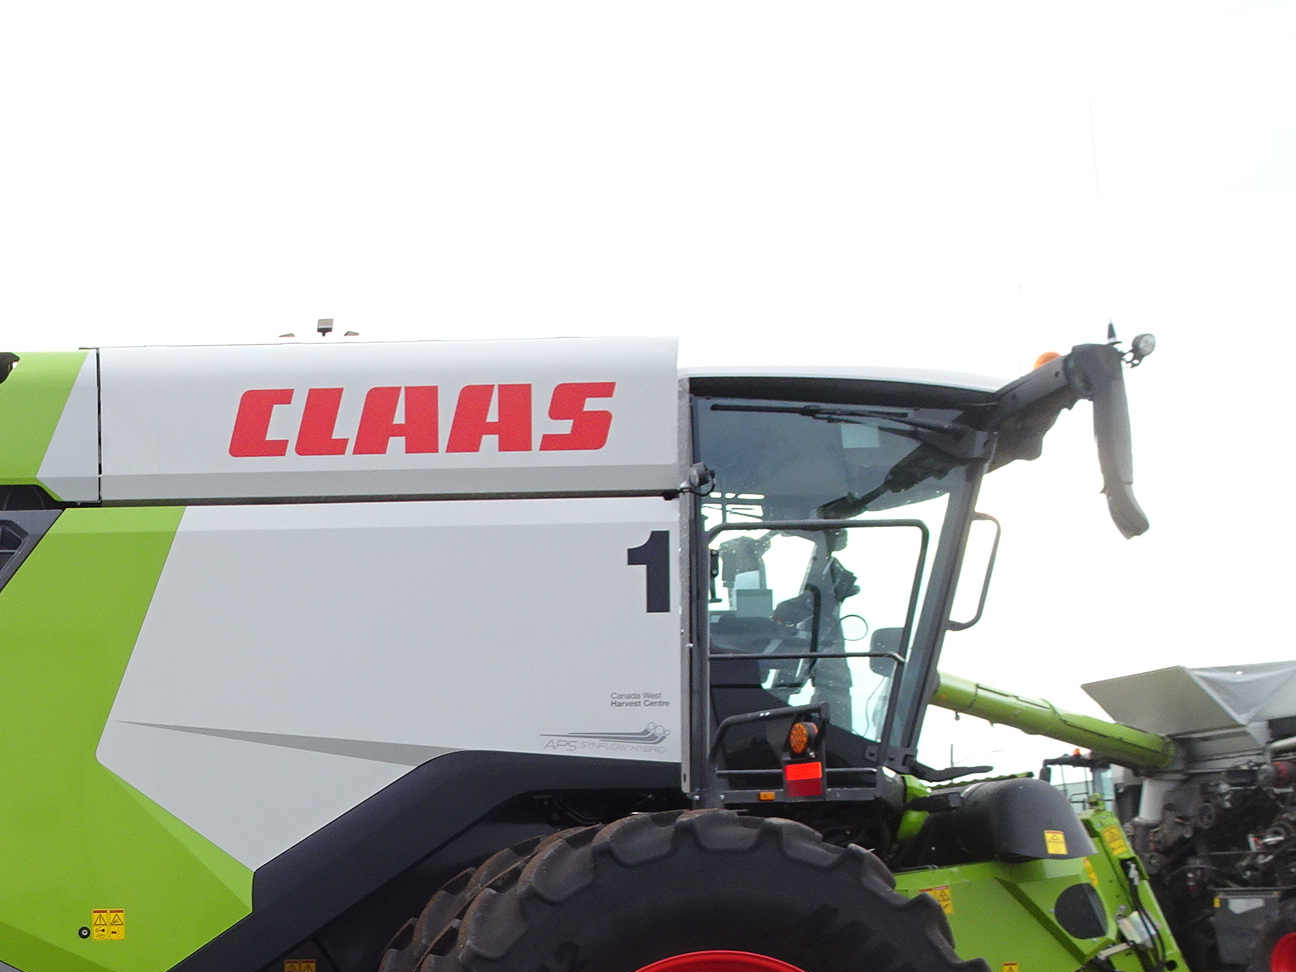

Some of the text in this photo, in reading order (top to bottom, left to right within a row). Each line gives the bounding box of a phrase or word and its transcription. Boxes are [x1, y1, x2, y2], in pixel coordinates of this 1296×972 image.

[229, 382, 616, 457] CLAAS
[627, 530, 670, 613] 1
[543, 739, 579, 751] APS
